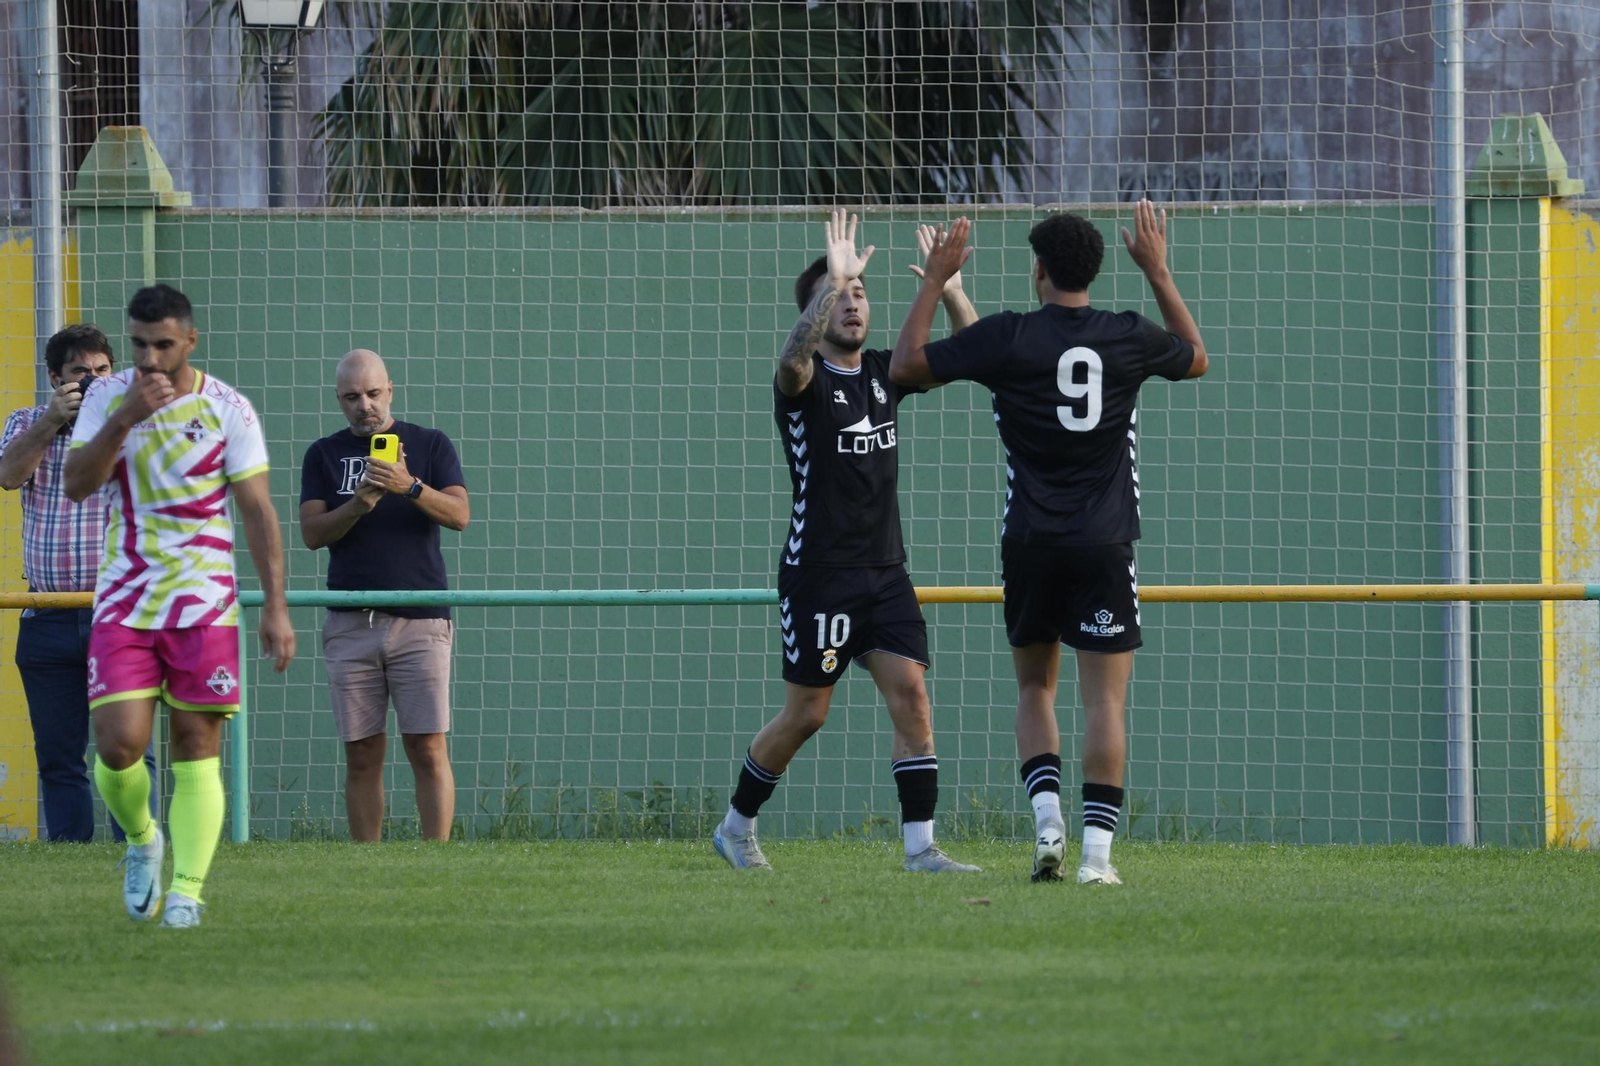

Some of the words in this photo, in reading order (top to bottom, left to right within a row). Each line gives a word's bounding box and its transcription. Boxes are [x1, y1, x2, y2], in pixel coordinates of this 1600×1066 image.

[1056, 346, 1103, 432] 9
[837, 427, 897, 454] LOTUS
[813, 612, 850, 649] 10
[1080, 622, 1098, 633] Ruiz
